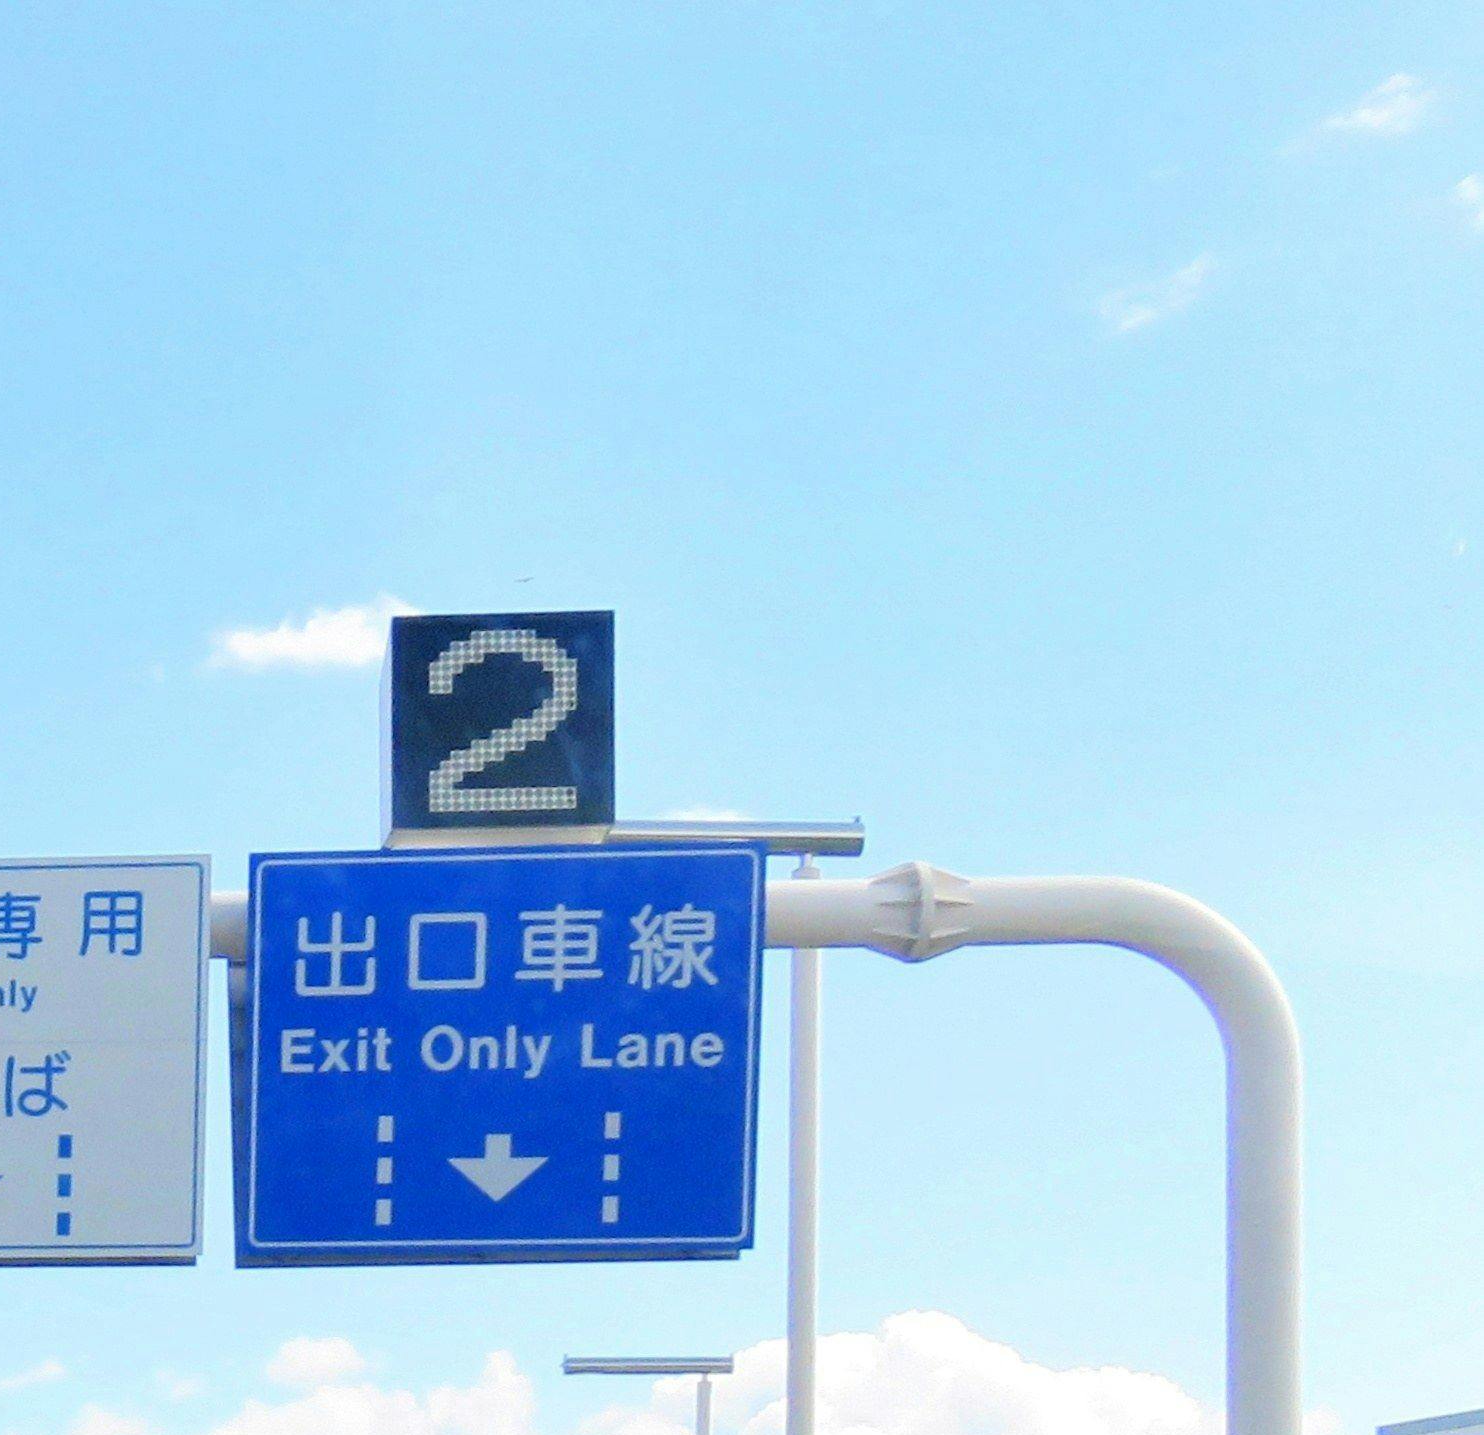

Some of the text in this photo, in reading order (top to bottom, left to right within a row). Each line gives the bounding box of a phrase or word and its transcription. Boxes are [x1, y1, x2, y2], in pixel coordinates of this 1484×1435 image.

[429, 629, 578, 812] 2
[294, 903, 720, 997] 出口車線
[280, 1022, 724, 1079] Exit Only Lane
